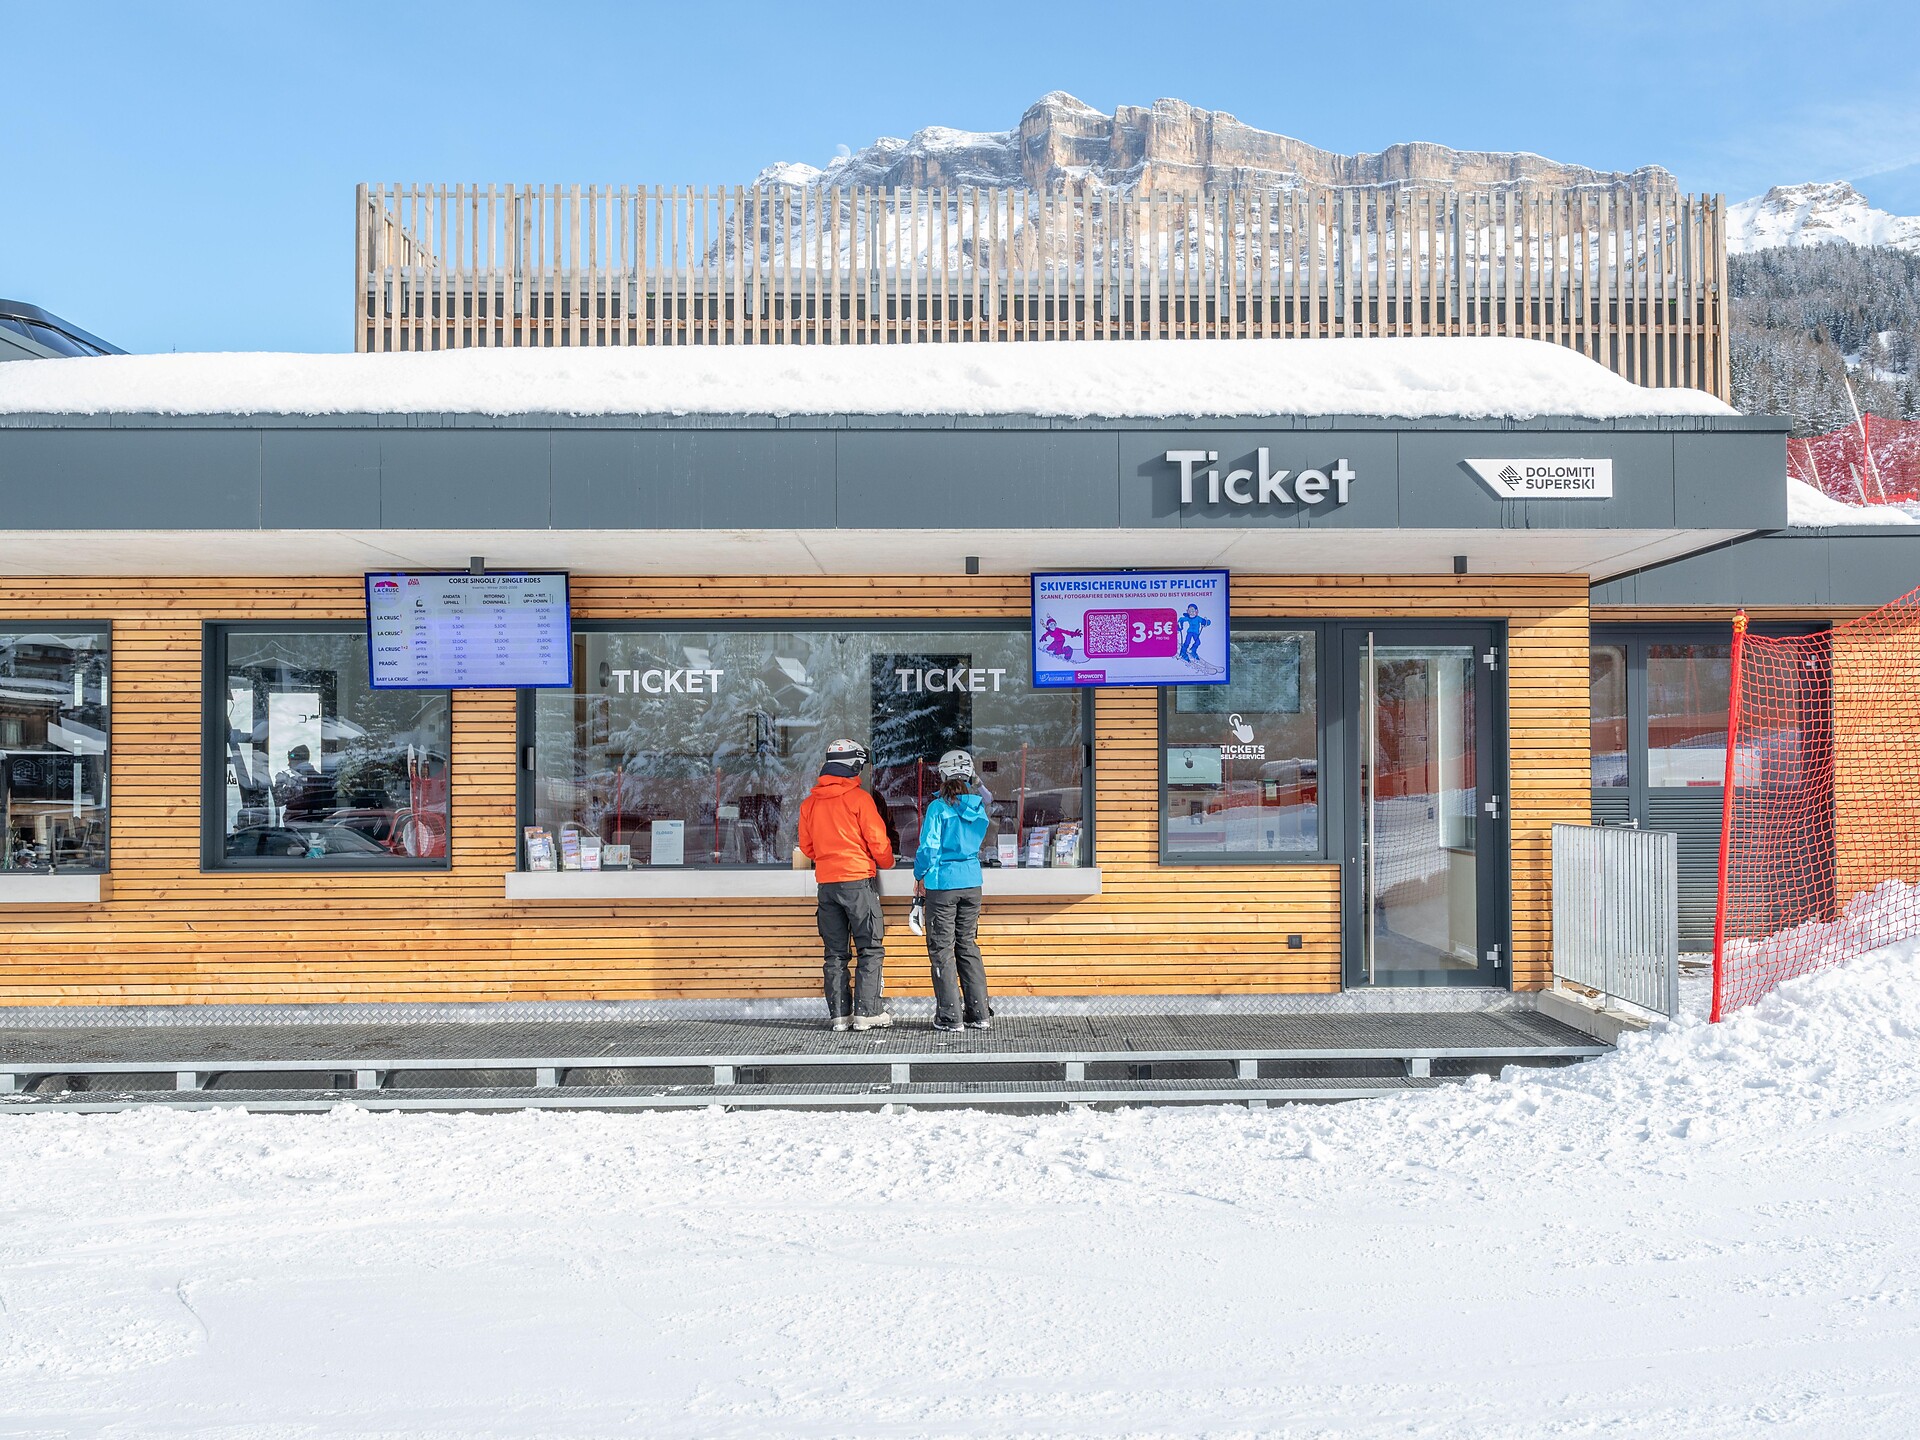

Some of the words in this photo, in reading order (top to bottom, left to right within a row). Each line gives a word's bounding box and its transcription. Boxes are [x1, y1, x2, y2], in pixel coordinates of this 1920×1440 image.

[1165, 447, 1356, 504] Ticket
[1526, 467, 1595, 478] DOLOMITI
[1526, 479, 1595, 490] SUPERSKI
[1040, 581, 1147, 592] SKIVERSICHERUNG
[1150, 580, 1168, 590] IST
[1170, 579, 1217, 589] PFLICHT
[1131, 621, 1173, 643] 3,5€
[611, 669, 724, 693] TICKET
[895, 668, 1006, 692] TICKET
[1220, 745, 1265, 754] TICKETS
